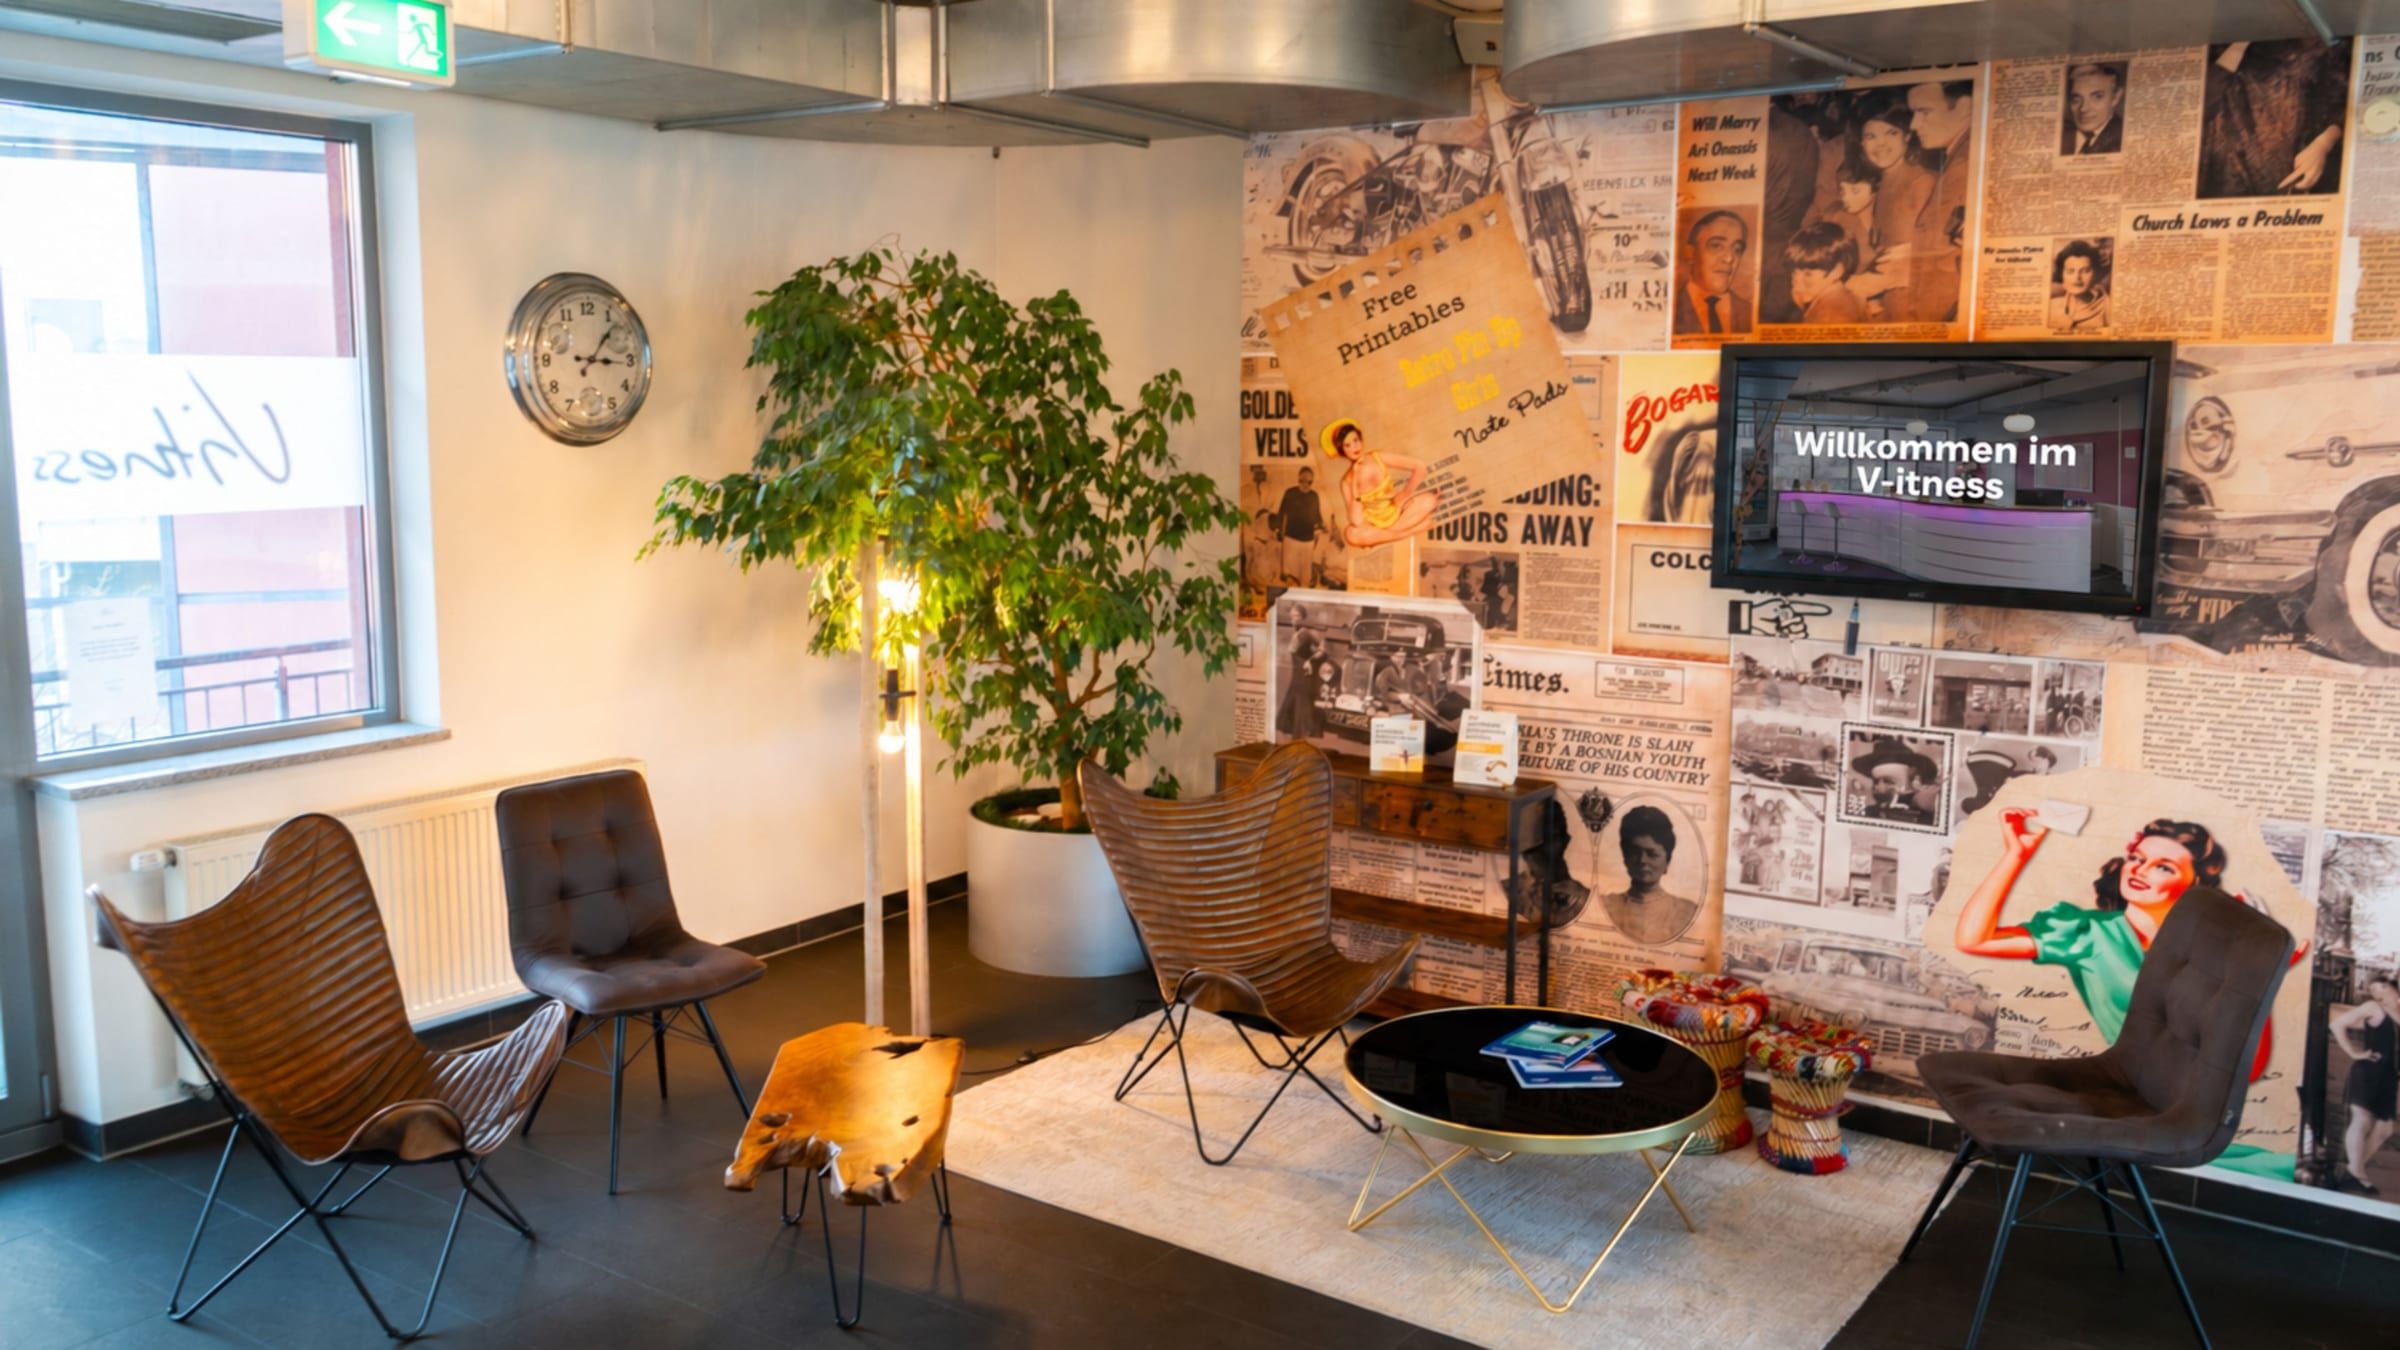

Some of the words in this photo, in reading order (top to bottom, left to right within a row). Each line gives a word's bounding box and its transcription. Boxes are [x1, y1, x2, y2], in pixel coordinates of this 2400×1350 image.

[1692, 115, 1718, 132] Will
[1719, 115, 1761, 133] Marry
[1688, 142, 1709, 158] Ari
[1711, 139, 1758, 157] Onassis
[1687, 168, 1718, 183] Next
[1722, 163, 1757, 180] Week
[2132, 212, 2184, 231] Church
[2190, 212, 2230, 230] Laws
[2237, 215, 2248, 228] a
[2253, 206, 2324, 228] Problem
[580, 301, 595, 316] 12
[1362, 283, 1418, 321] Free
[560, 308, 573, 322] 11
[605, 309, 612, 323] 1
[1337, 295, 1466, 366] Printables
[626, 353, 636, 368] 3
[550, 380, 560, 394] 8
[620, 379, 630, 392] 4
[565, 399, 575, 413] 7
[608, 396, 617, 410] 5
[1453, 413, 1510, 449] Note
[1507, 380, 1569, 418] Pads
[1254, 427, 1309, 458] VEILS
[1794, 430, 2016, 464] Willkommen
[2029, 435, 2076, 466] im
[1856, 465, 2004, 499] V-itness
[1521, 514, 1594, 547] AWAY
[1562, 728, 1624, 747] THRONE
[1627, 735, 1643, 749] IS
[1646, 737, 1694, 753] SLAIN
[1535, 741, 1557, 756] BY
[1559, 744, 1571, 757] A
[1575, 745, 1644, 763] BOSNIAN
[1649, 752, 1706, 770] YOUTH
[1603, 762, 1629, 778] HIS
[1632, 766, 1711, 786] COUNTRY
